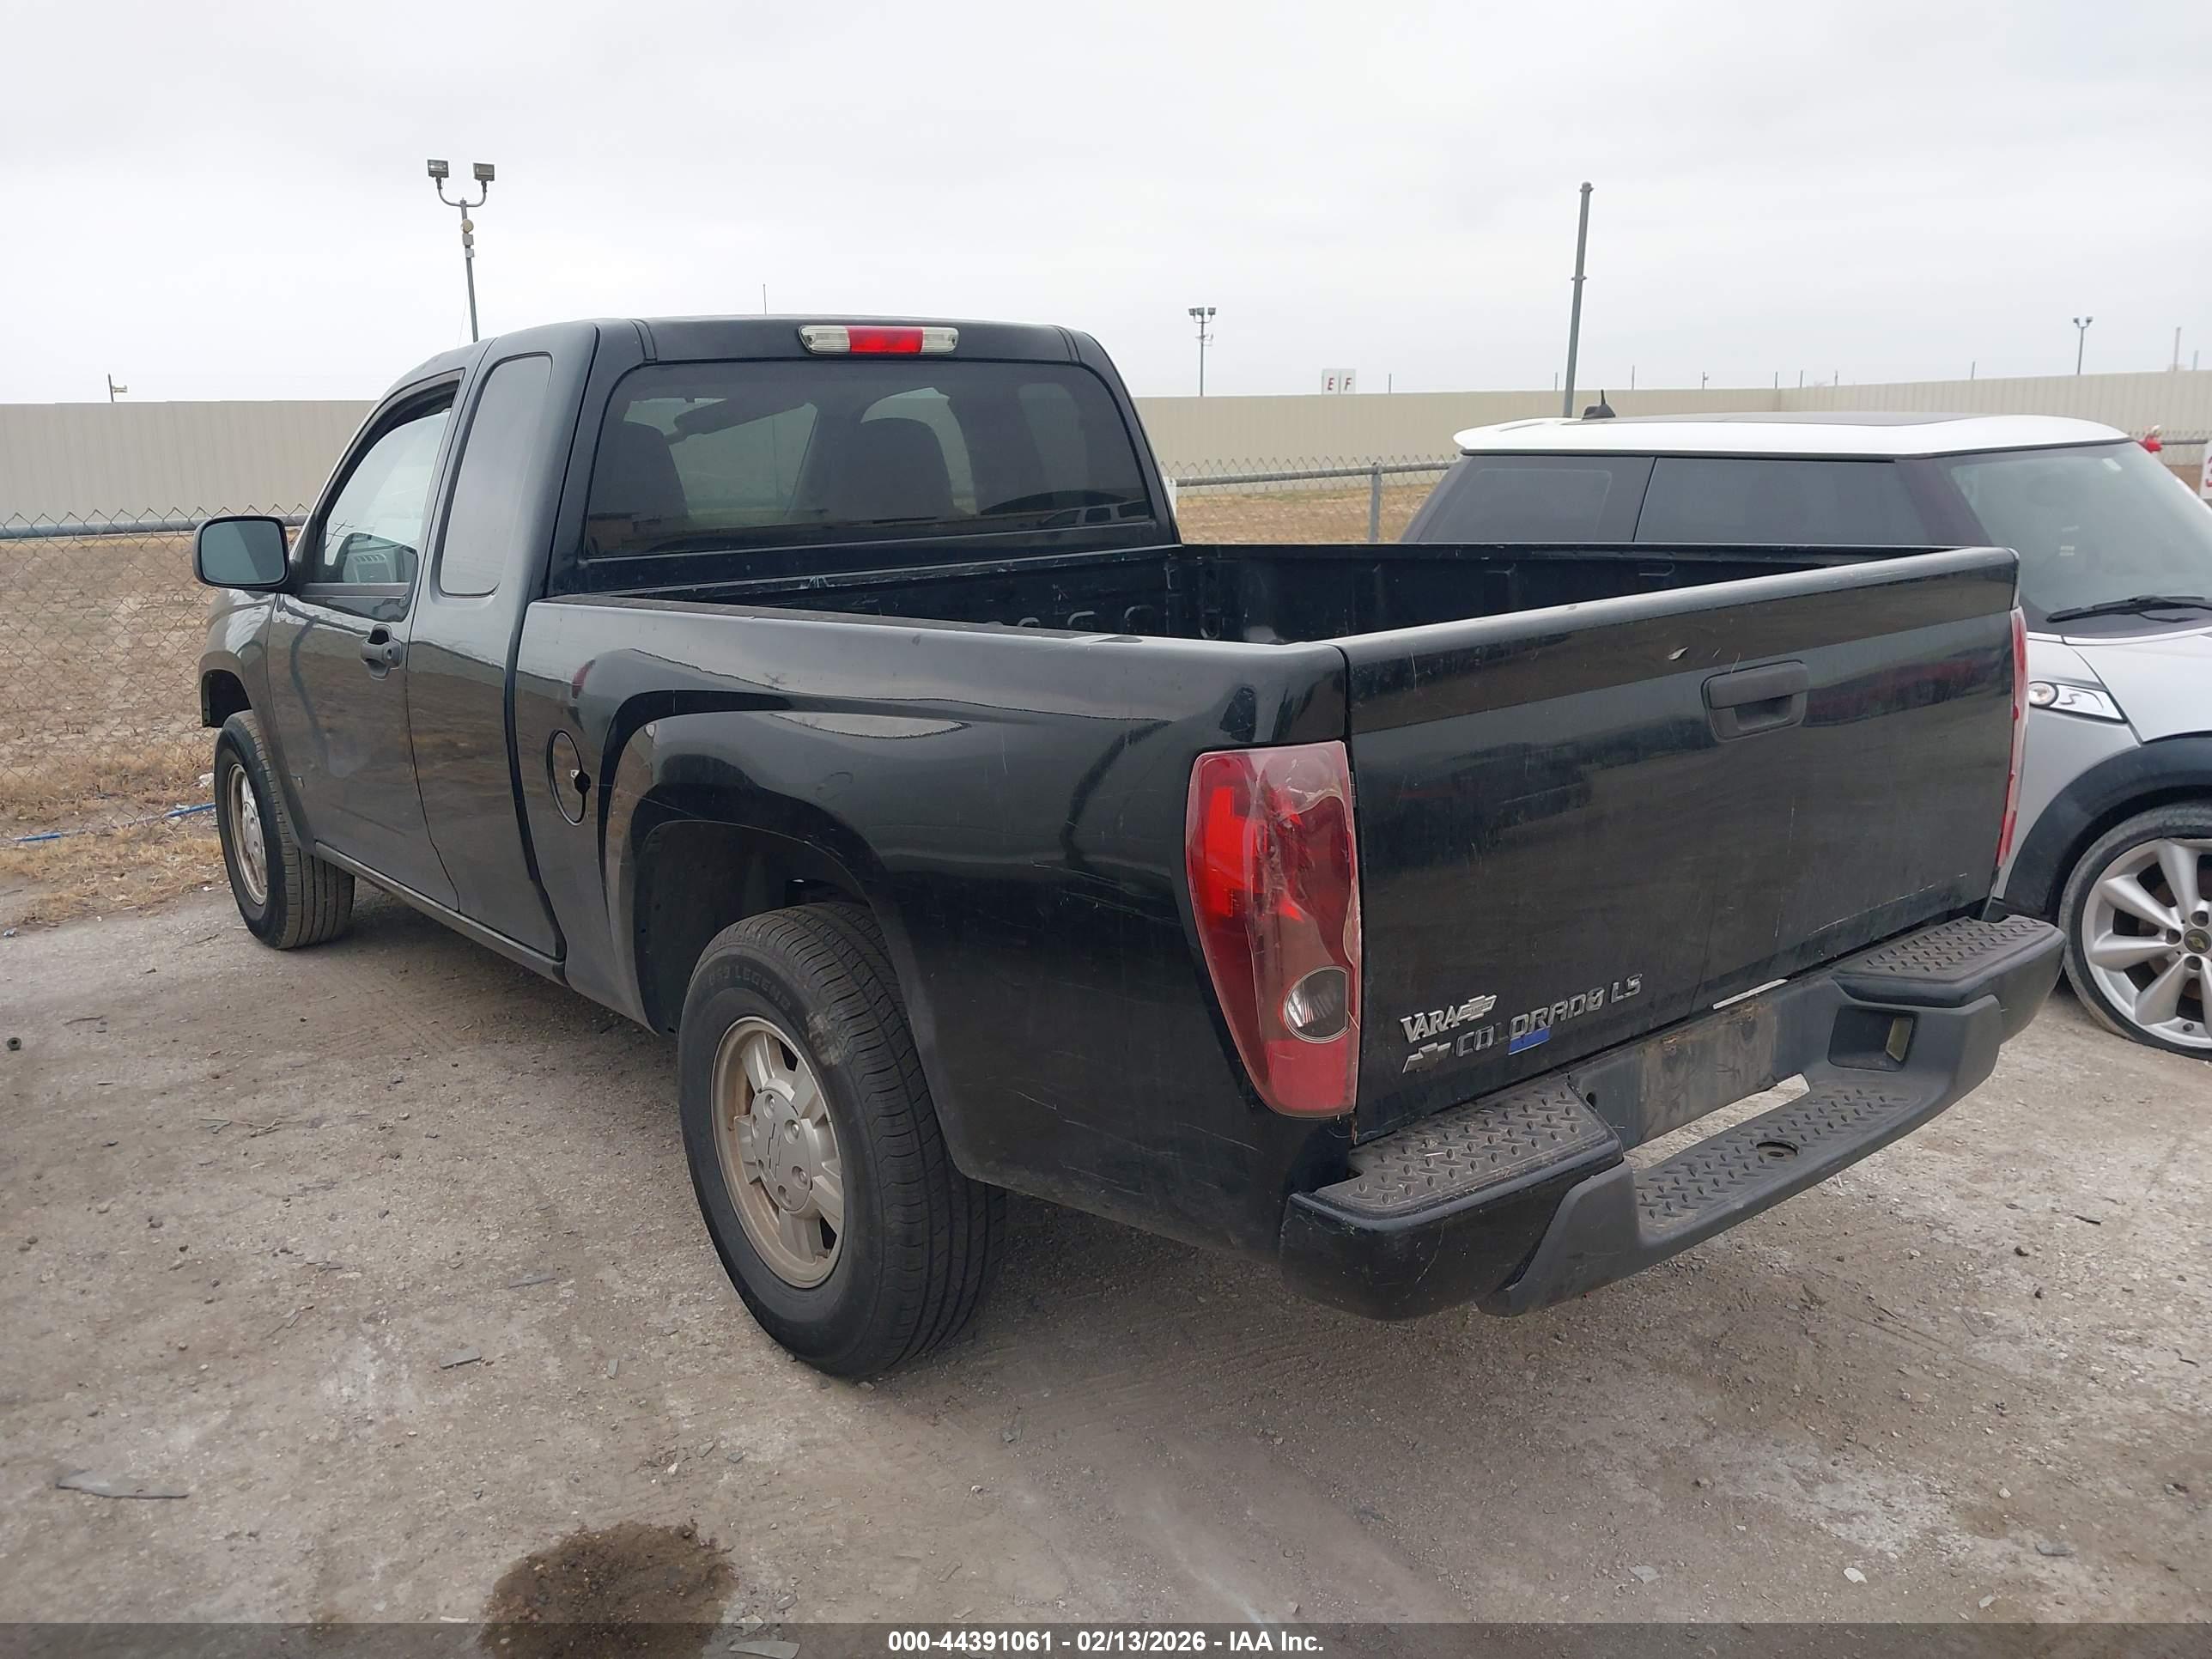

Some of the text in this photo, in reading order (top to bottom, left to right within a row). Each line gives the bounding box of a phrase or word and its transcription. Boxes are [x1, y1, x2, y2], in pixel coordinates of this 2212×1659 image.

[1328, 377, 1334, 391] E
[1344, 377, 1352, 391] F
[1611, 974, 1642, 1003] LS
[1400, 1005, 1460, 1043] VARA
